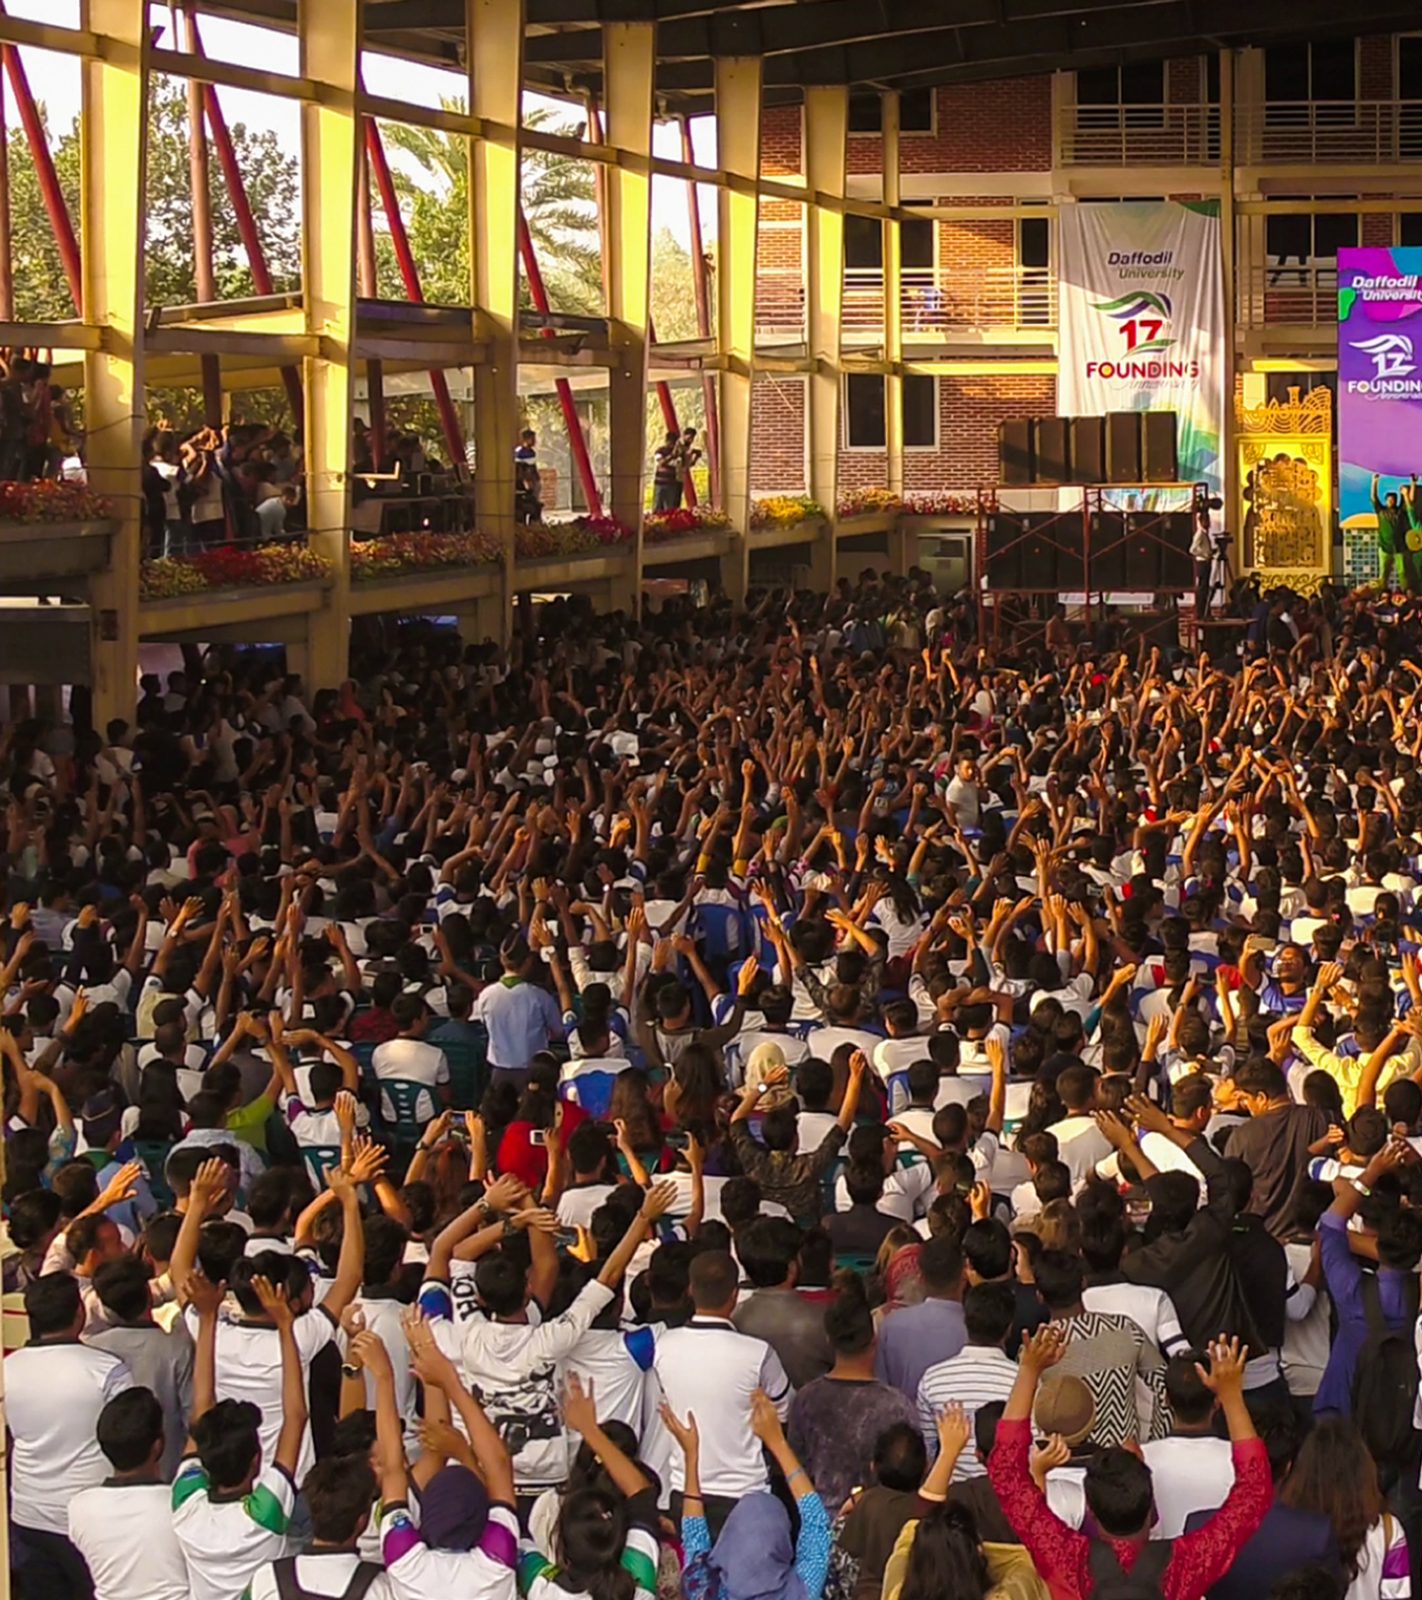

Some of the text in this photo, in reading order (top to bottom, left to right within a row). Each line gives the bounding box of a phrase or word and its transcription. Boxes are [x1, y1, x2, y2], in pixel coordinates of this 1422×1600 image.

[1107, 251, 1174, 266] Daffodil
[1119, 267, 1185, 281] University
[1351, 275, 1419, 289] Daffodil
[1086, 361, 1200, 379] FOUNDING
